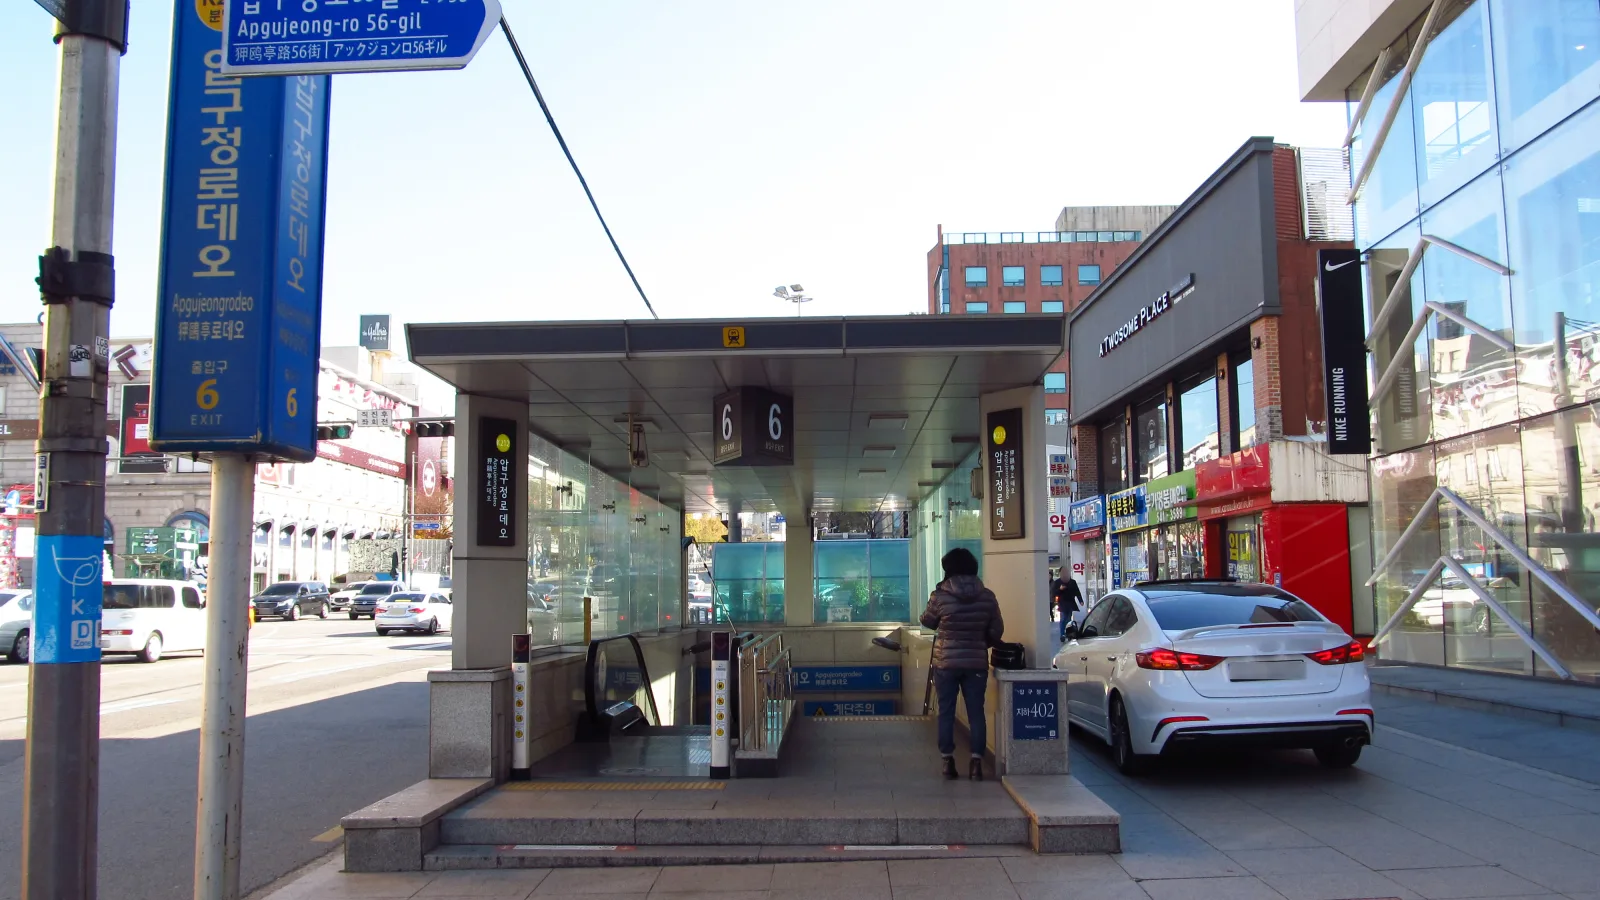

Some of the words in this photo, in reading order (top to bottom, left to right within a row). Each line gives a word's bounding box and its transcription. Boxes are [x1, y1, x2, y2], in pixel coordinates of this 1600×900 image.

[238, 17, 359, 40] Apgujeong-ro
[367, 12, 422, 35] 56-gil
[172, 290, 254, 318] Apgujeongrodeo
[1099, 343, 1104, 358] A
[1103, 315, 1139, 353] TWOSOME
[1140, 291, 1168, 326] PLACE
[191, 360, 228, 375] 출입구
[196, 379, 220, 410] 6
[286, 388, 298, 418] 6
[1332, 367, 1346, 414] RUNNING
[190, 414, 223, 426] EXIT
[722, 403, 733, 441] 6
[768, 403, 782, 440] 6
[1335, 416, 1347, 441] NIKE
[1050, 463, 1070, 473] 부동산
[499, 458, 510, 538] 압구정로데오
[994, 450, 1005, 532] 압구정로데오
[1049, 514, 1067, 531] 약
[72, 599, 85, 615] K
[77, 622, 90, 639] D
[882, 671, 891, 682] 6
